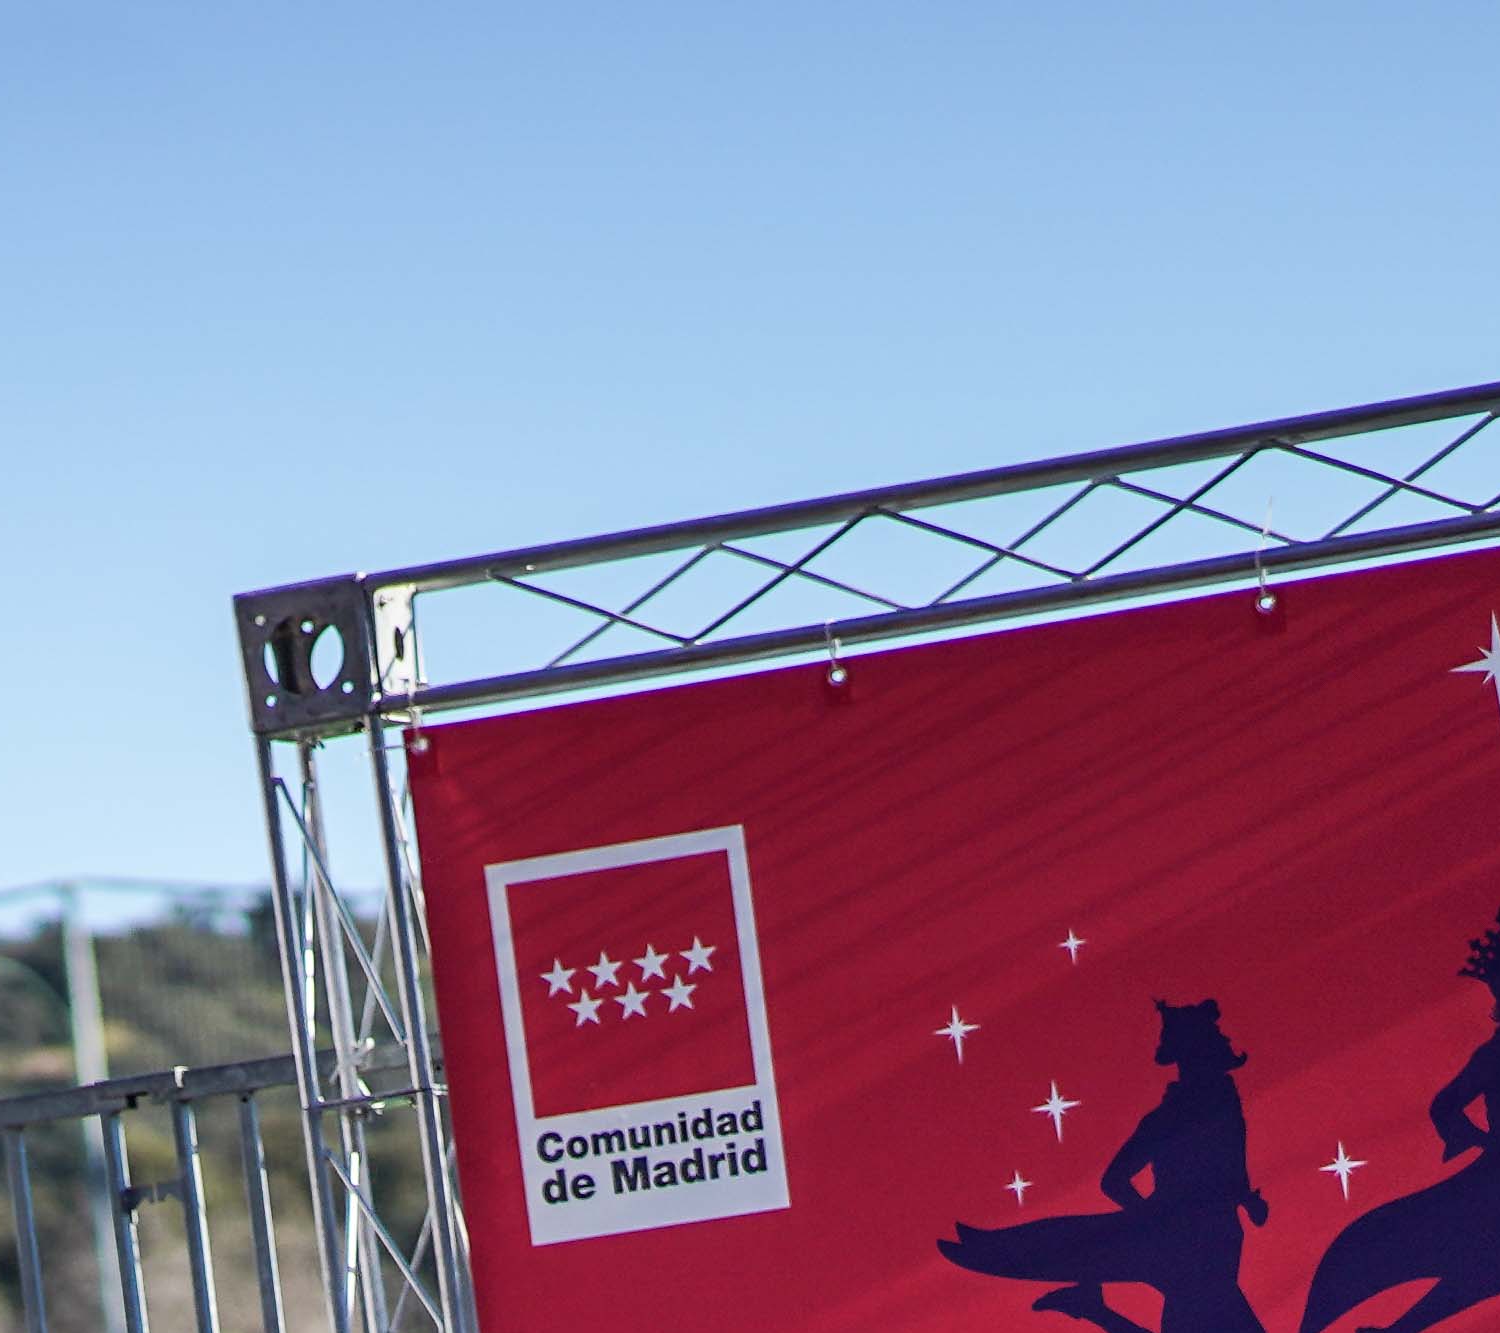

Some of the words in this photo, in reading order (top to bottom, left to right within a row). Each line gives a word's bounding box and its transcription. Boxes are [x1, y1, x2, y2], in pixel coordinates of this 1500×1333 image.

[536, 1100, 764, 1164] Comunidad
[542, 1168, 596, 1204] de
[610, 1138, 767, 1195] Madrid
